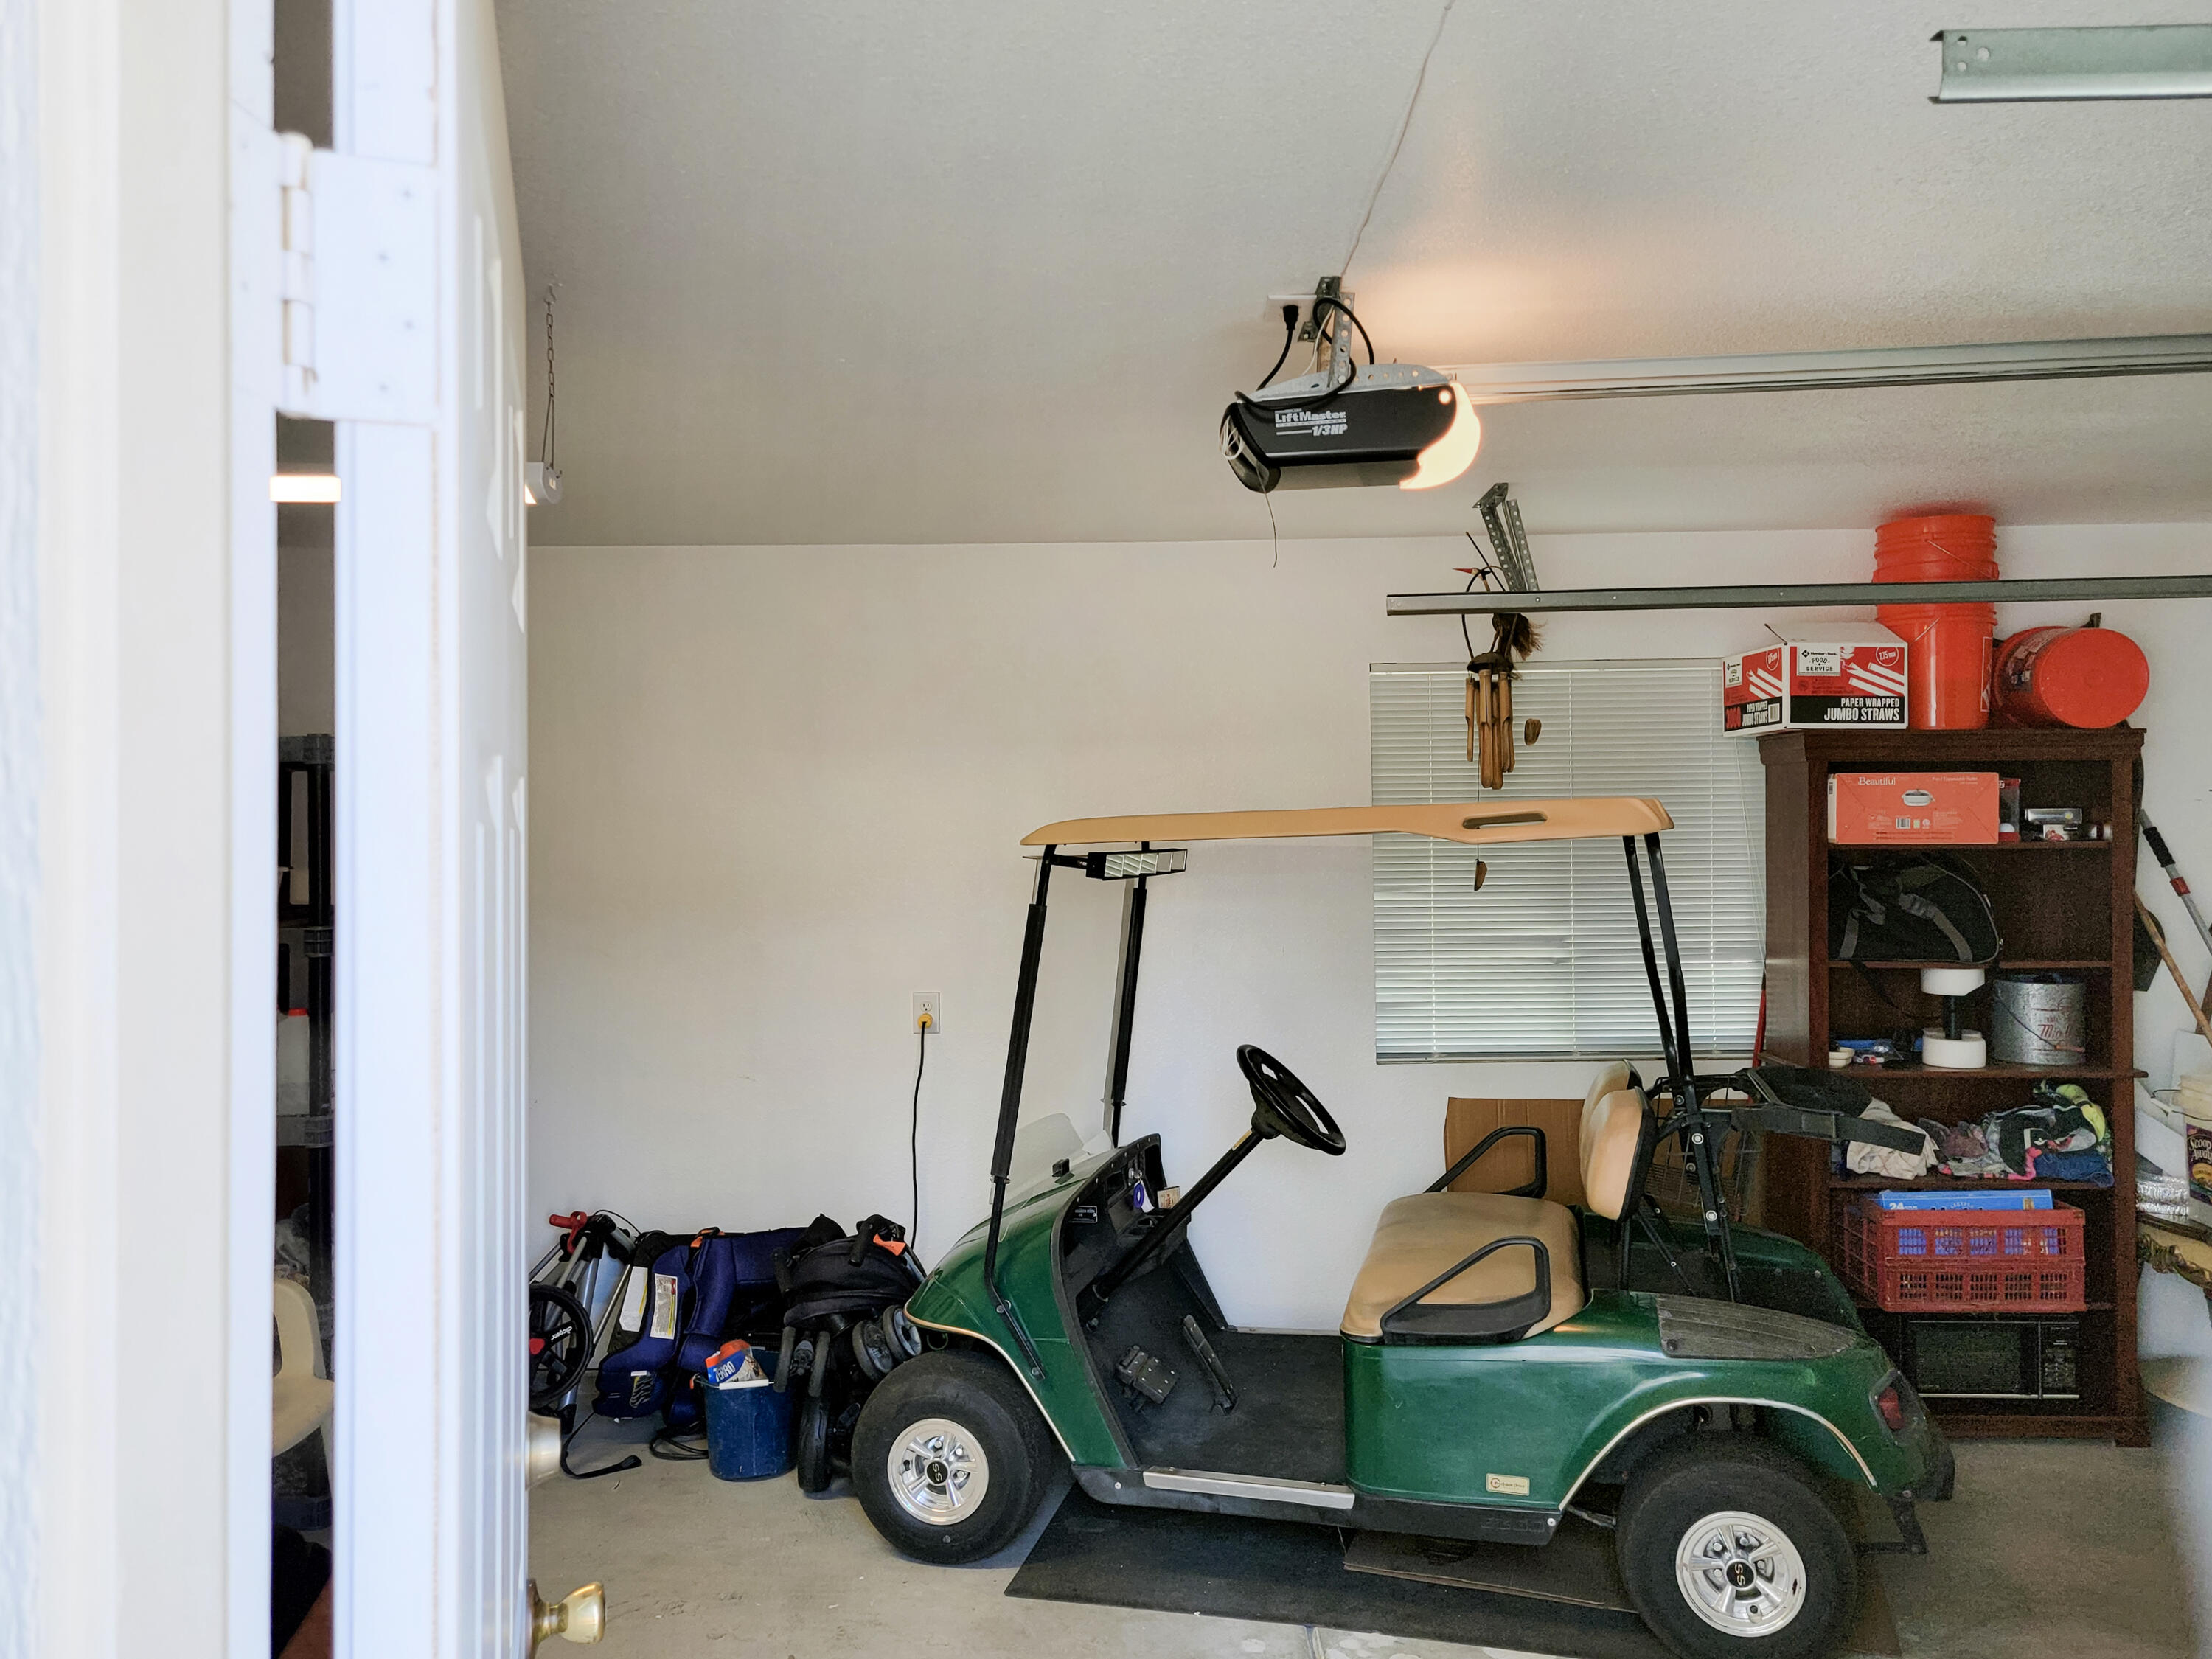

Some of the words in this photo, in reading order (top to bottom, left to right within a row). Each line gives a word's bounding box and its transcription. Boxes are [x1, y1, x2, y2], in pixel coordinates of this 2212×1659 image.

[1275, 410, 1346, 422] LiftMaster
[1840, 698, 1864, 707] PAPER
[1865, 698, 1900, 707] WRAPPED
[1824, 707, 1859, 721] JUMBO
[1860, 707, 1900, 721] STRAWS
[1858, 776, 1896, 785] Beautiful
[2189, 1137, 2212, 1151] Scoop
[1889, 1202, 1905, 1210] 24
[932, 1462, 942, 1482] SS
[1734, 1563, 1746, 1586] SS
